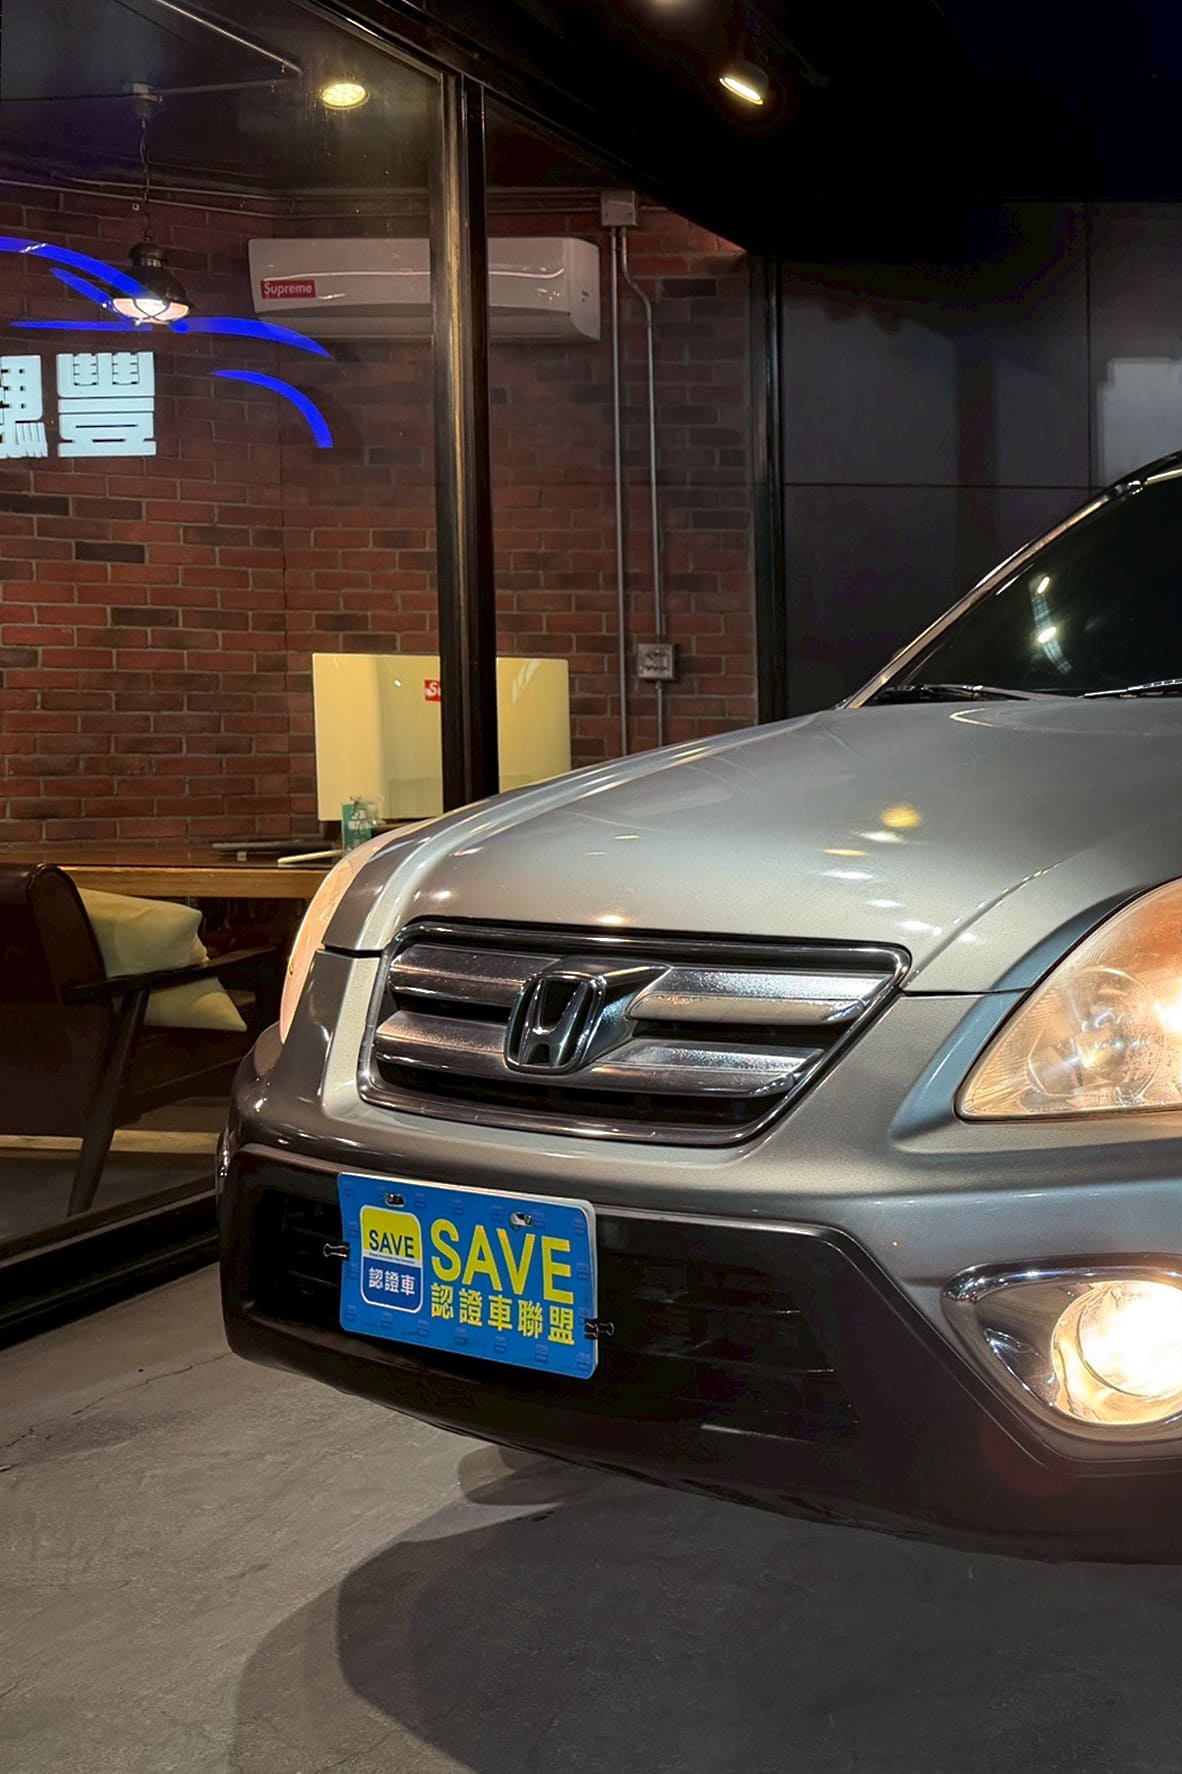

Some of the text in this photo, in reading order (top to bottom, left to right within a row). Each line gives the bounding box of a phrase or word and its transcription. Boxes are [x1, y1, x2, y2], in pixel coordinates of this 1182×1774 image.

[263, 281, 313, 297] Supreme
[368, 1229, 415, 1259] SAVE
[430, 1218, 575, 1305] SAVE
[368, 1266, 416, 1296] 認證車
[430, 1282, 576, 1346] 認證車聯盟
